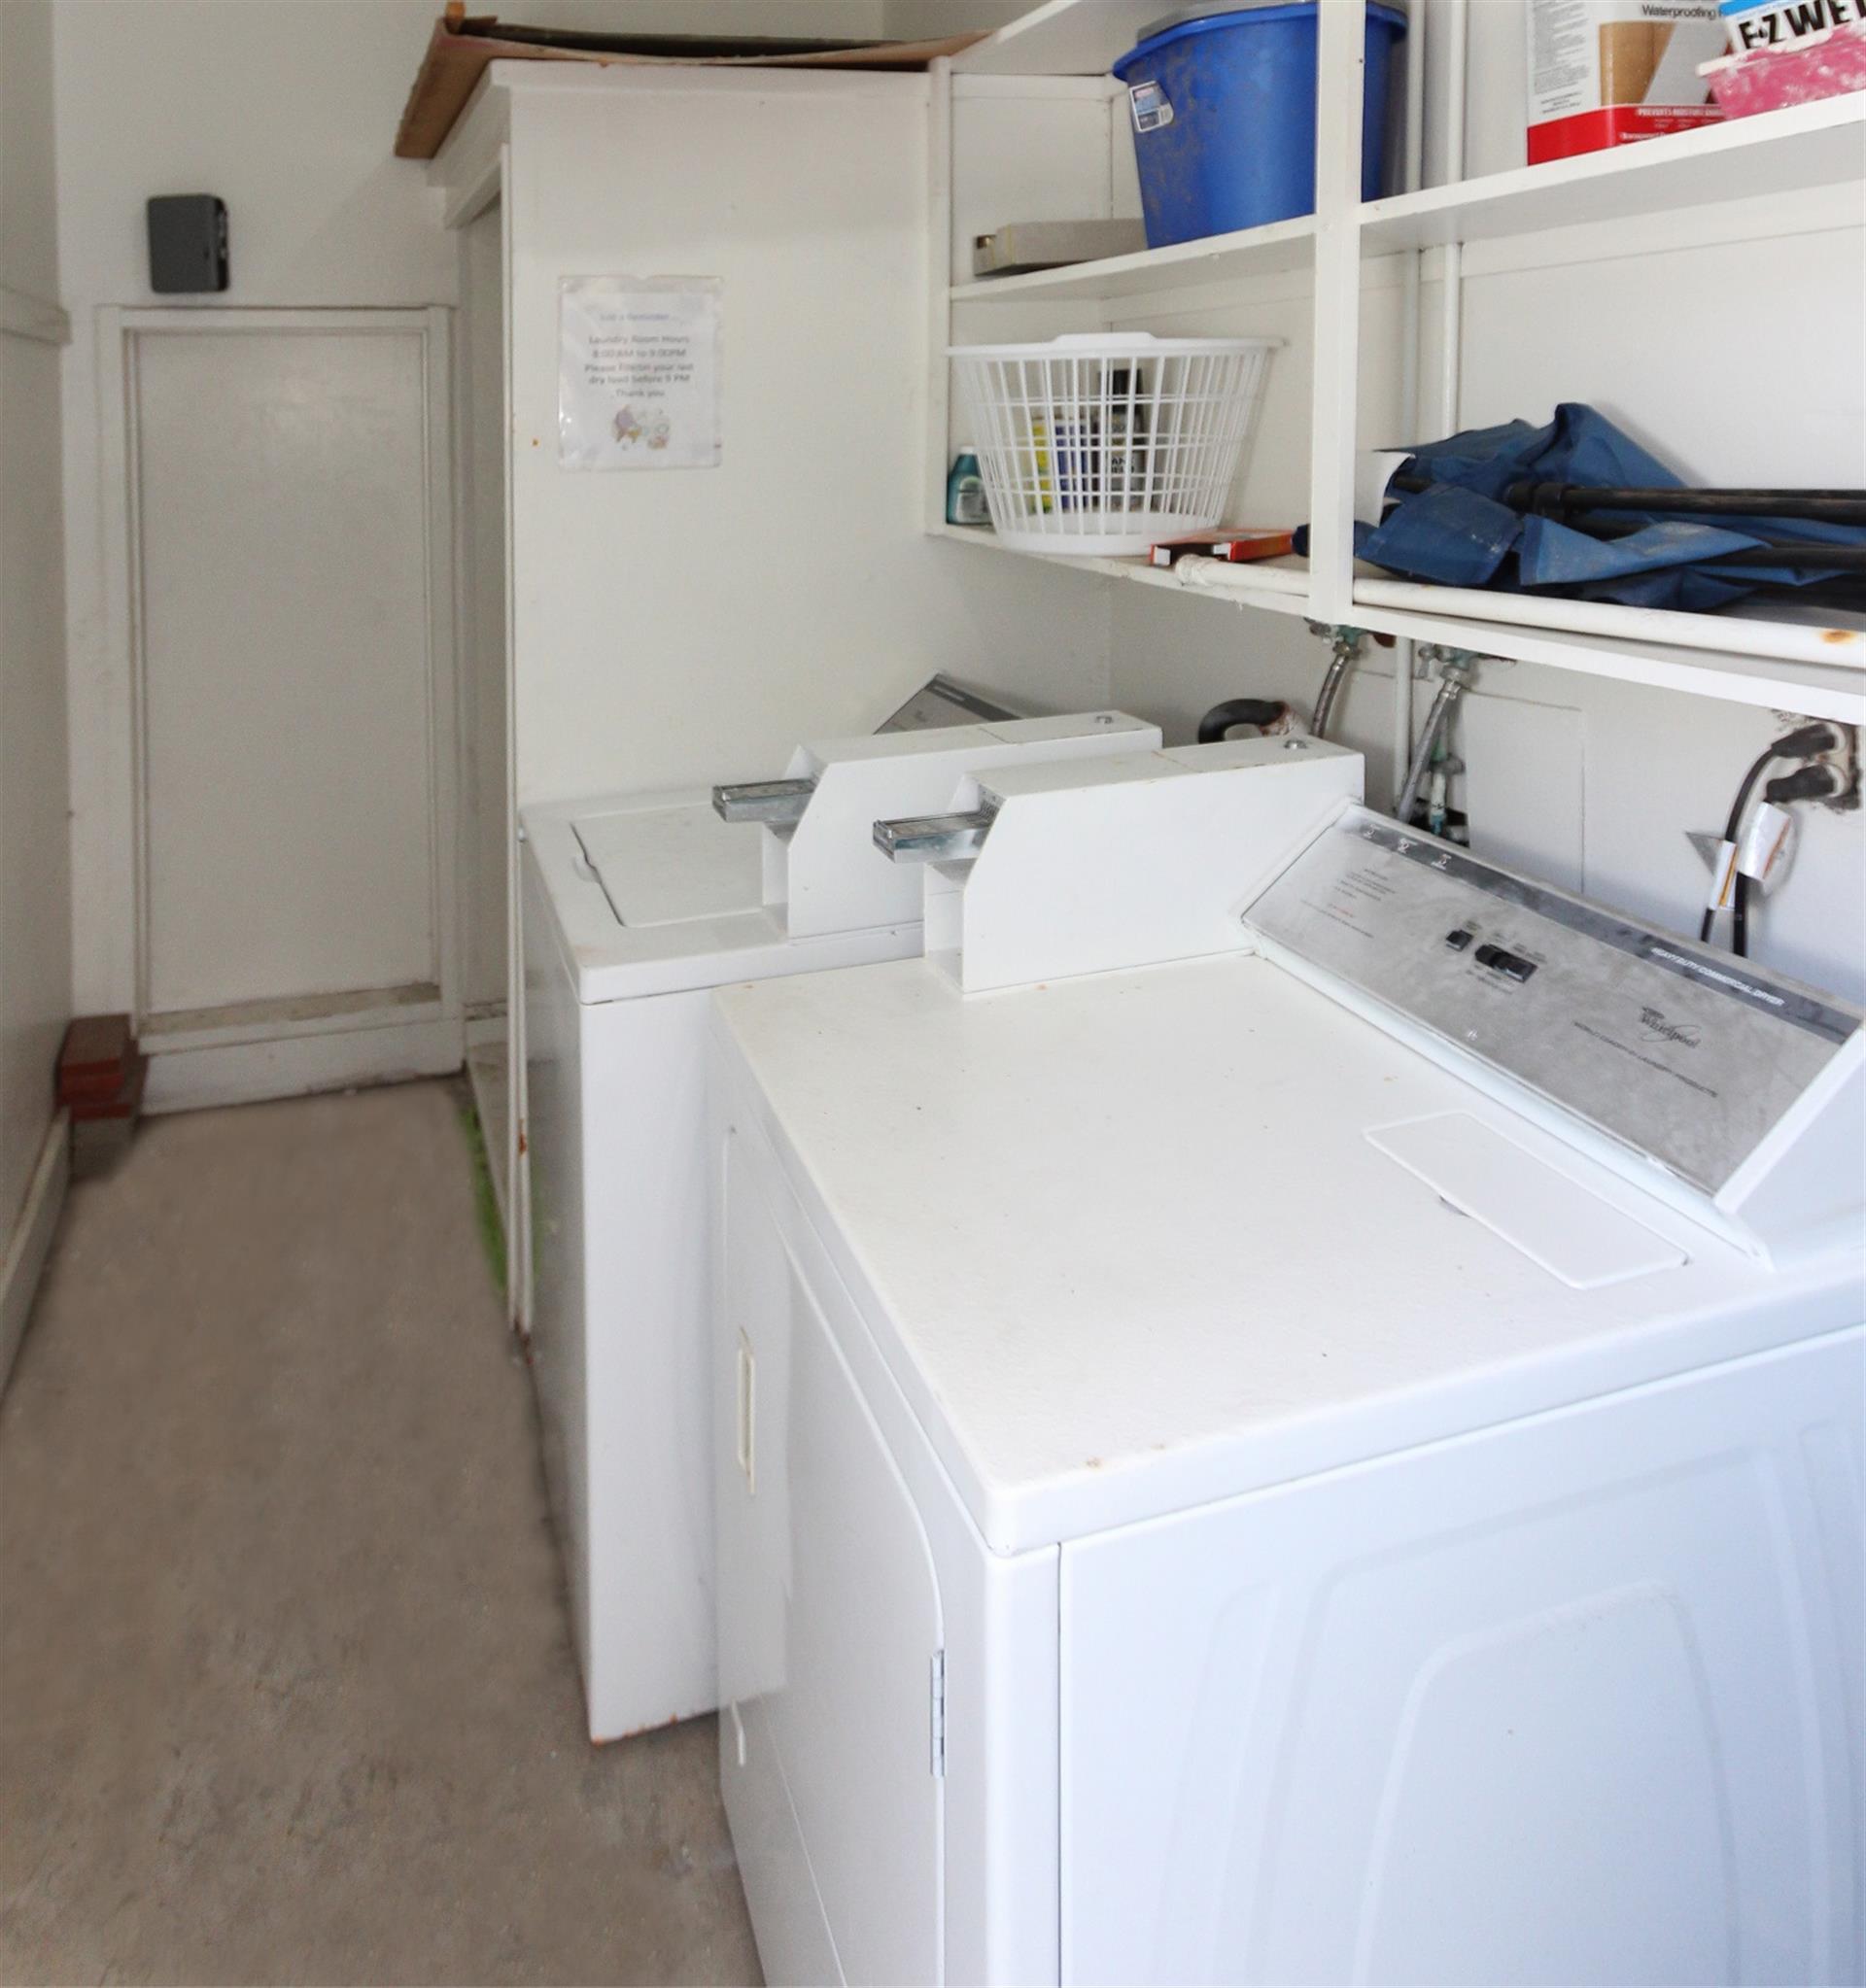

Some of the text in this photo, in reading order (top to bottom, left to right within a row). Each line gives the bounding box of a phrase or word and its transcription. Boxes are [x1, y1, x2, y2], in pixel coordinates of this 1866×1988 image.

[1641, 5, 1716, 20] Waterproofing
[589, 335, 628, 345] Laundry
[584, 363, 616, 373] Please
[653, 364, 674, 374] your
[589, 374, 605, 385] dry
[631, 374, 663, 384] before
[674, 373, 691, 383] PM
[615, 388, 645, 397] Thank
[1651, 946, 1677, 961] HEAVY
[1676, 955, 1701, 971] DUTY
[1698, 966, 1753, 994] COMMERCIAL
[1640, 1007, 1701, 1048] Whirlpool
